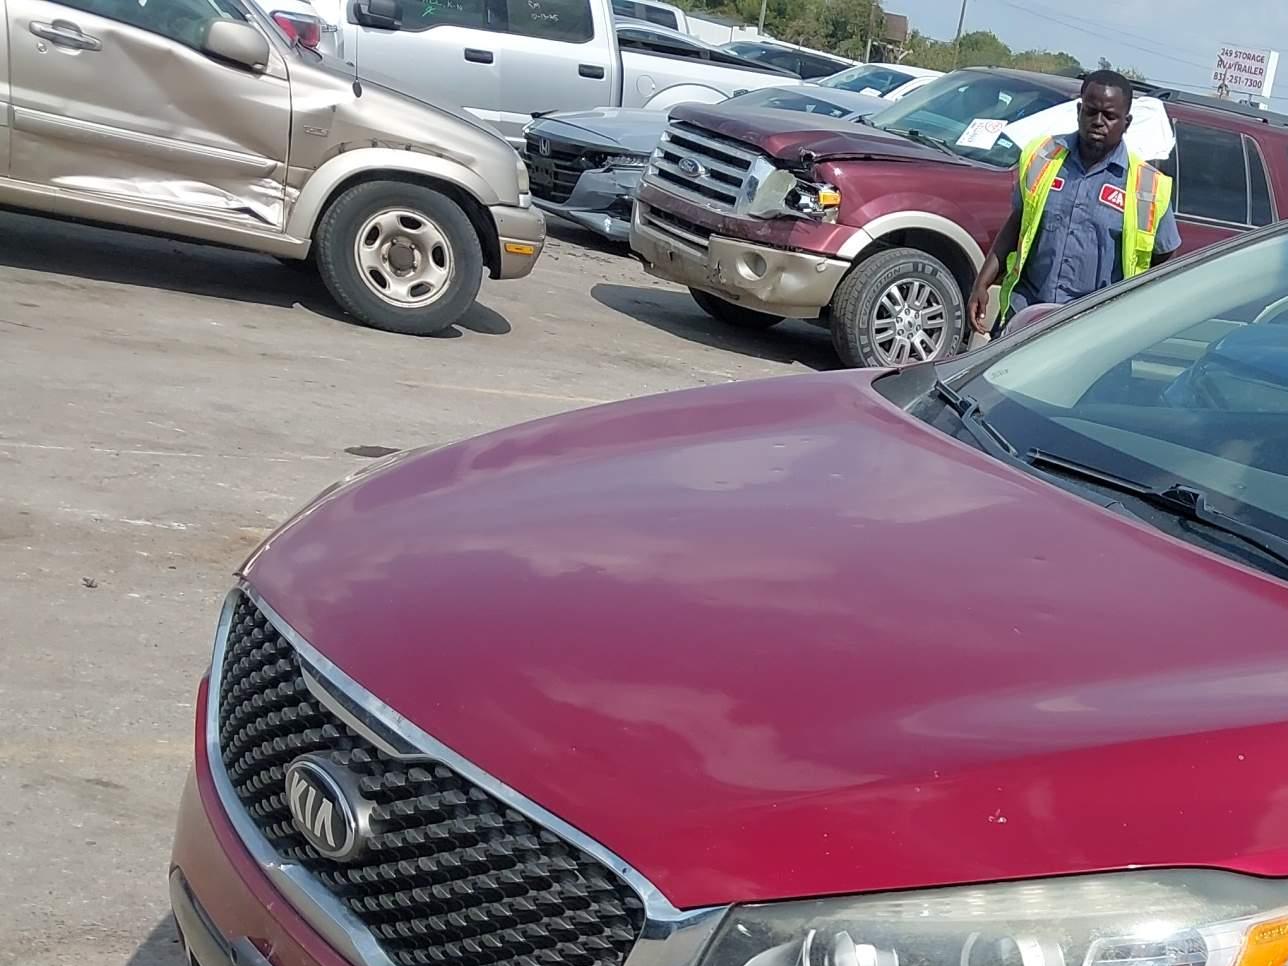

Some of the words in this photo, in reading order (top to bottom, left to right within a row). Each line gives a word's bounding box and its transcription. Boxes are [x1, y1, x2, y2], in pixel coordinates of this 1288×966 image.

[1220, 48, 1234, 57] 249
[1234, 50, 1265, 64] STORAGE
[1232, 62, 1264, 77] TRAILER
